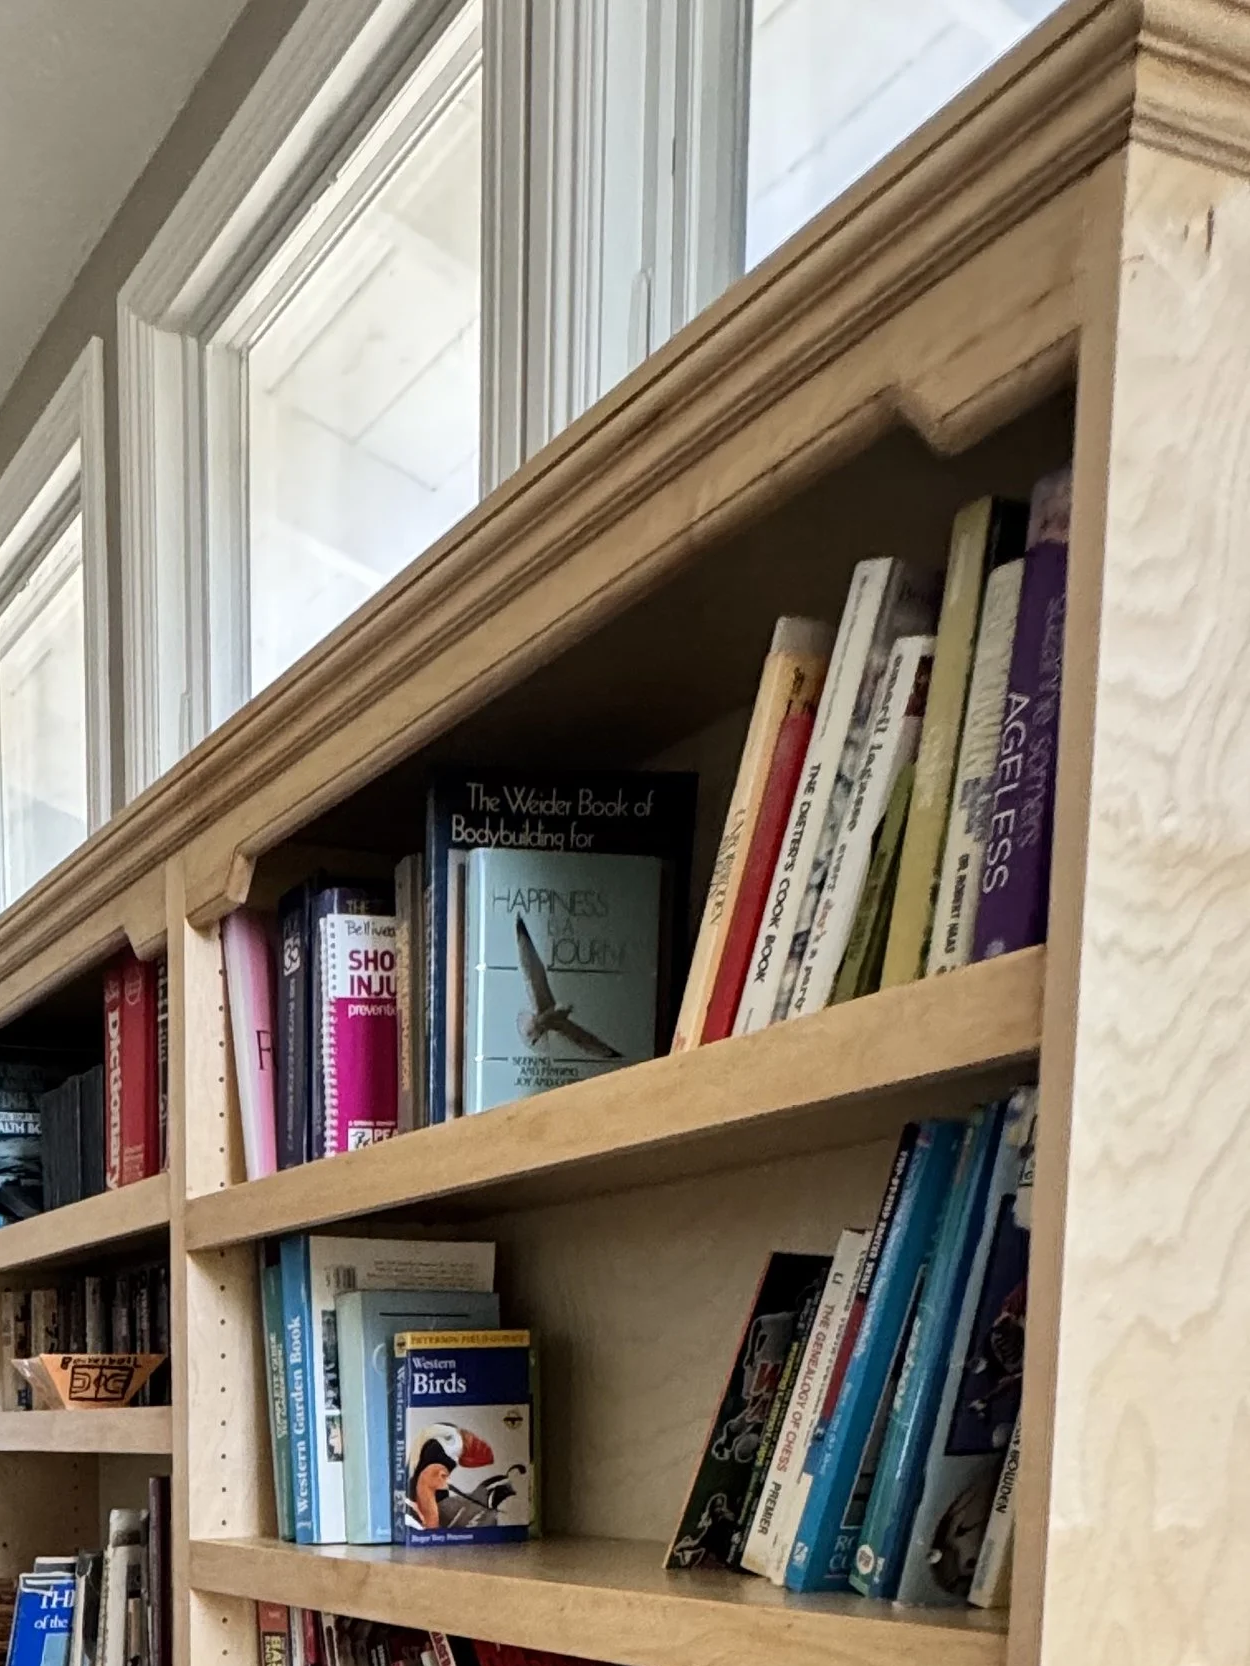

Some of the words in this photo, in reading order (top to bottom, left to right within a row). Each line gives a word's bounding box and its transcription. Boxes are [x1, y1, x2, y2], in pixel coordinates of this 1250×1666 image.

[466, 781, 501, 813] The
[502, 785, 573, 817] Weider
[578, 787, 629, 817] Book
[634, 789, 655, 817] of
[983, 692, 1030, 895] AGELESS
[452, 813, 565, 850] Bodybuilding
[570, 820, 596, 849] for
[493, 887, 610, 917] HAPPINESS
[768, 877, 791, 929] COOK
[349, 949, 396, 972] SHO
[753, 934, 776, 984] BOOK
[818, 1303, 837, 1330] THE
[286, 1315, 304, 1369] Book
[412, 1356, 457, 1370] Western
[798, 1329, 828, 1411] GENEALOGY
[291, 1368, 306, 1436] Garden
[412, 1372, 467, 1395] Birds
[790, 1411, 804, 1430] OF
[776, 1430, 799, 1474] CHESS
[296, 1440, 312, 1516] Western
[758, 1480, 783, 1536] PREMIER
[34, 1614, 51, 1630] of
[49, 1613, 69, 1629] the
